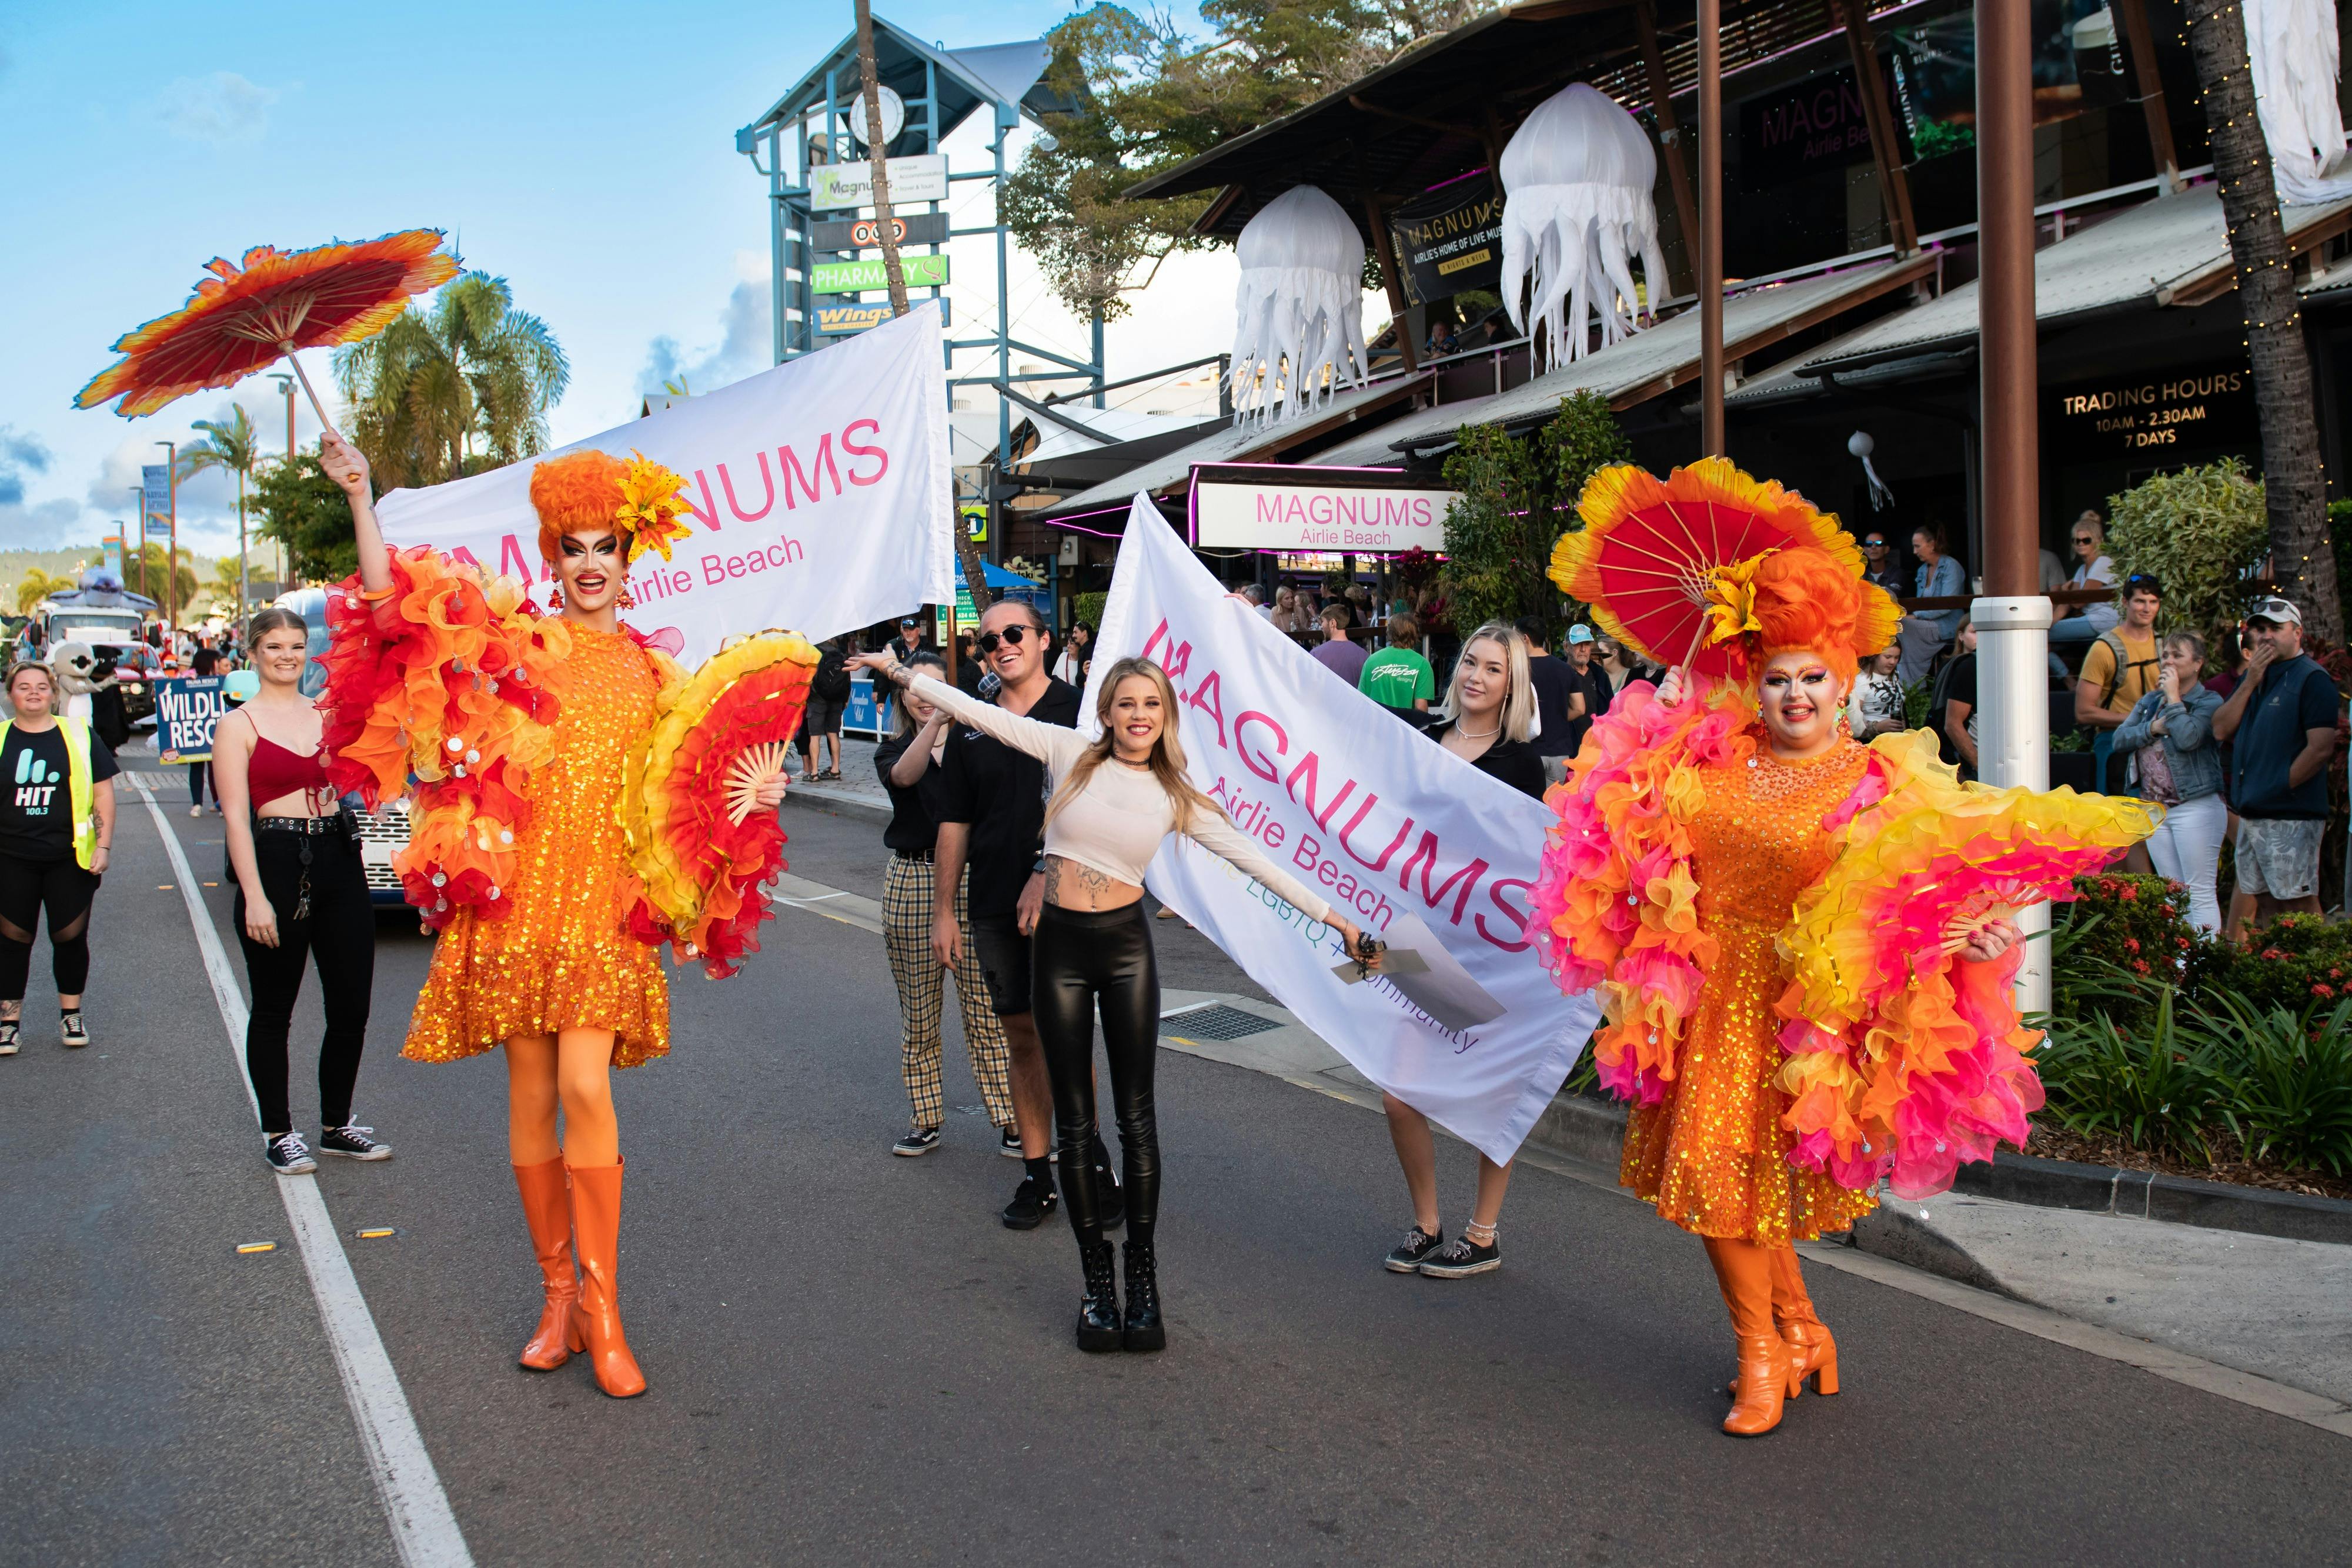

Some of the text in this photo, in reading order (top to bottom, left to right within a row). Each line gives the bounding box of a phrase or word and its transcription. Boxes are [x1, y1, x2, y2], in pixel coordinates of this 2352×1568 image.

[829, 179, 893, 196] Magnus
[1408, 198, 1502, 248] MAGNUMS
[1414, 226, 1502, 265] AIRLIE'S HOME OF LIVE MUS
[1472, 253, 1486, 263] WEEK
[816, 263, 918, 289] PHARMAY
[817, 307, 893, 326] Wings
[2064, 372, 2241, 415] TRADING HOURS
[2096, 415, 2134, 433] 10AM
[2149, 405, 2206, 426] 2.30AM
[2124, 429, 2176, 447] 7 DAYS
[1257, 493, 1432, 527] MAGNUMS
[1301, 528, 1391, 545] Airlie Beach
[630, 534, 804, 606] irlie Beach
[159, 690, 226, 722] WILDLI
[170, 718, 218, 748] RESC
[15, 786, 57, 806] HIT
[1141, 617, 1536, 952] MAGNUMS
[25, 807, 49, 815] 100.3
[1207, 775, 1393, 932] Airlie Beach
